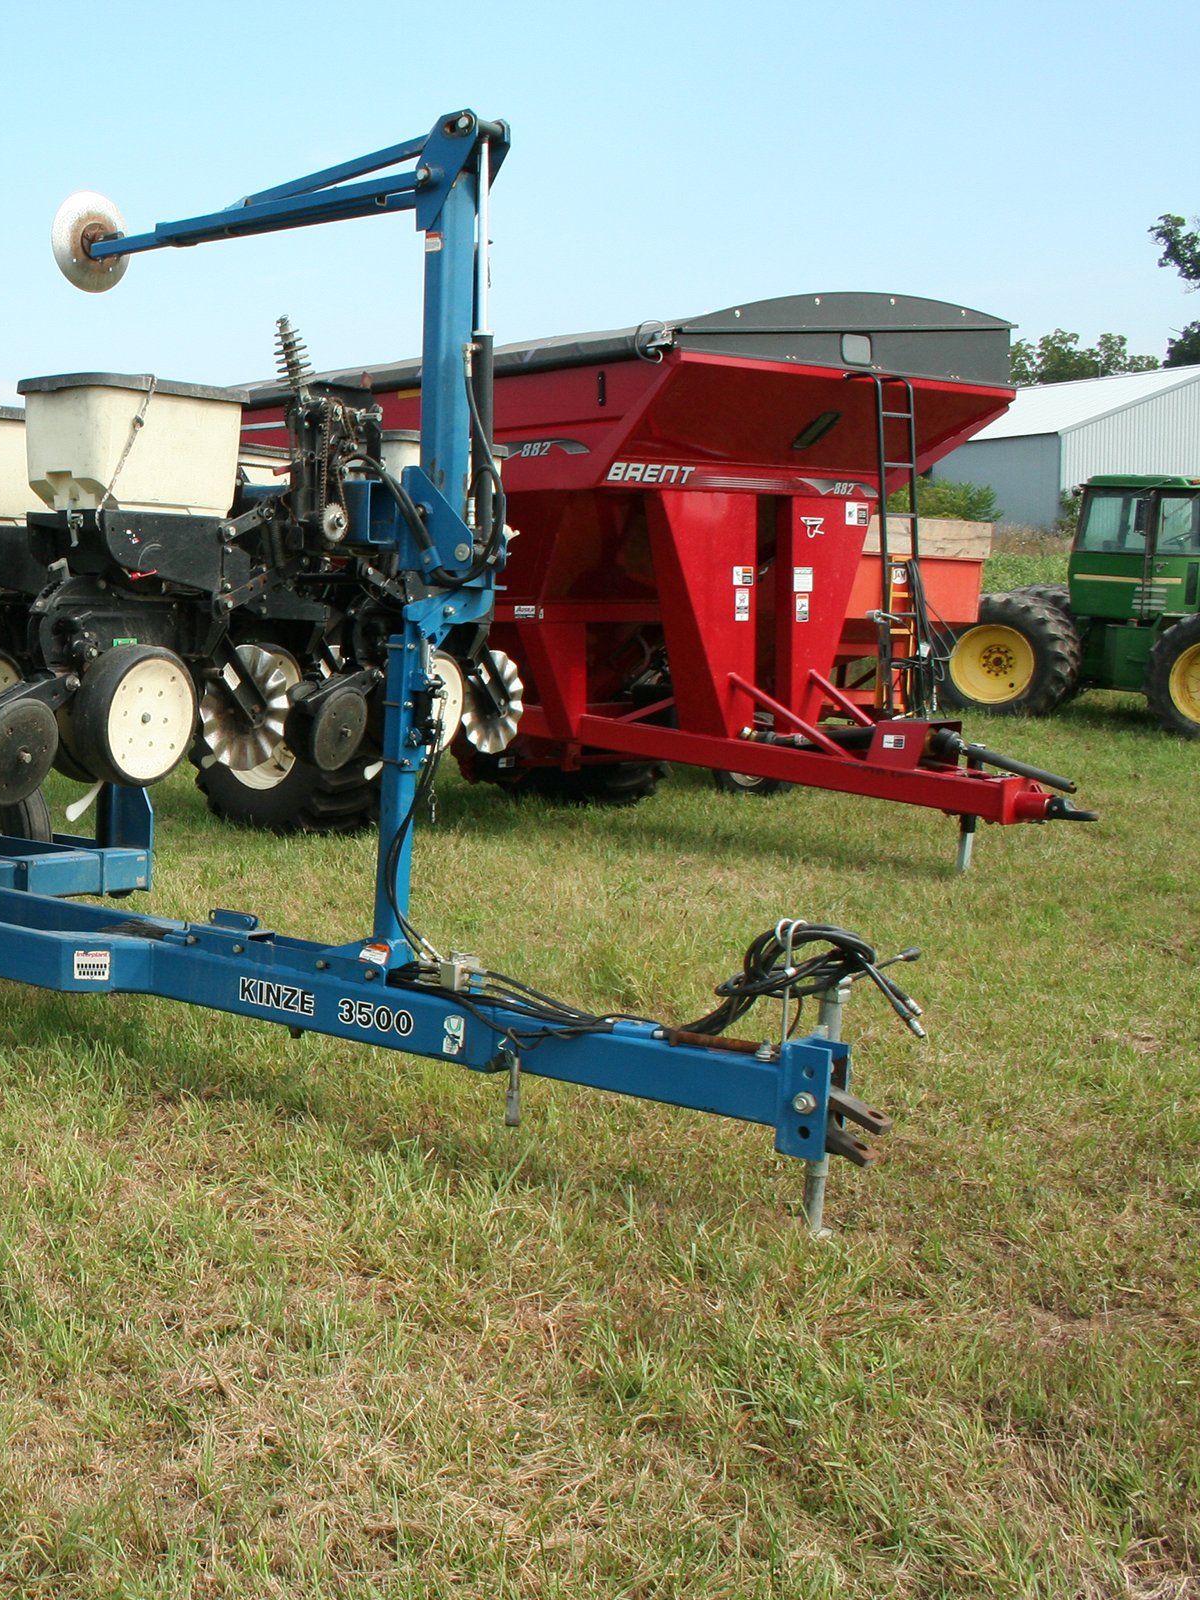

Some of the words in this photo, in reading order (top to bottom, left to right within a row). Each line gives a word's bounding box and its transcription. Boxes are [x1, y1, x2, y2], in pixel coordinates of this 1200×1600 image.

[521, 441, 551, 457] 882
[607, 462, 696, 484] BRENT
[833, 482, 855, 495] 882
[239, 976, 315, 1016] KINZE
[338, 998, 414, 1037] 3500
